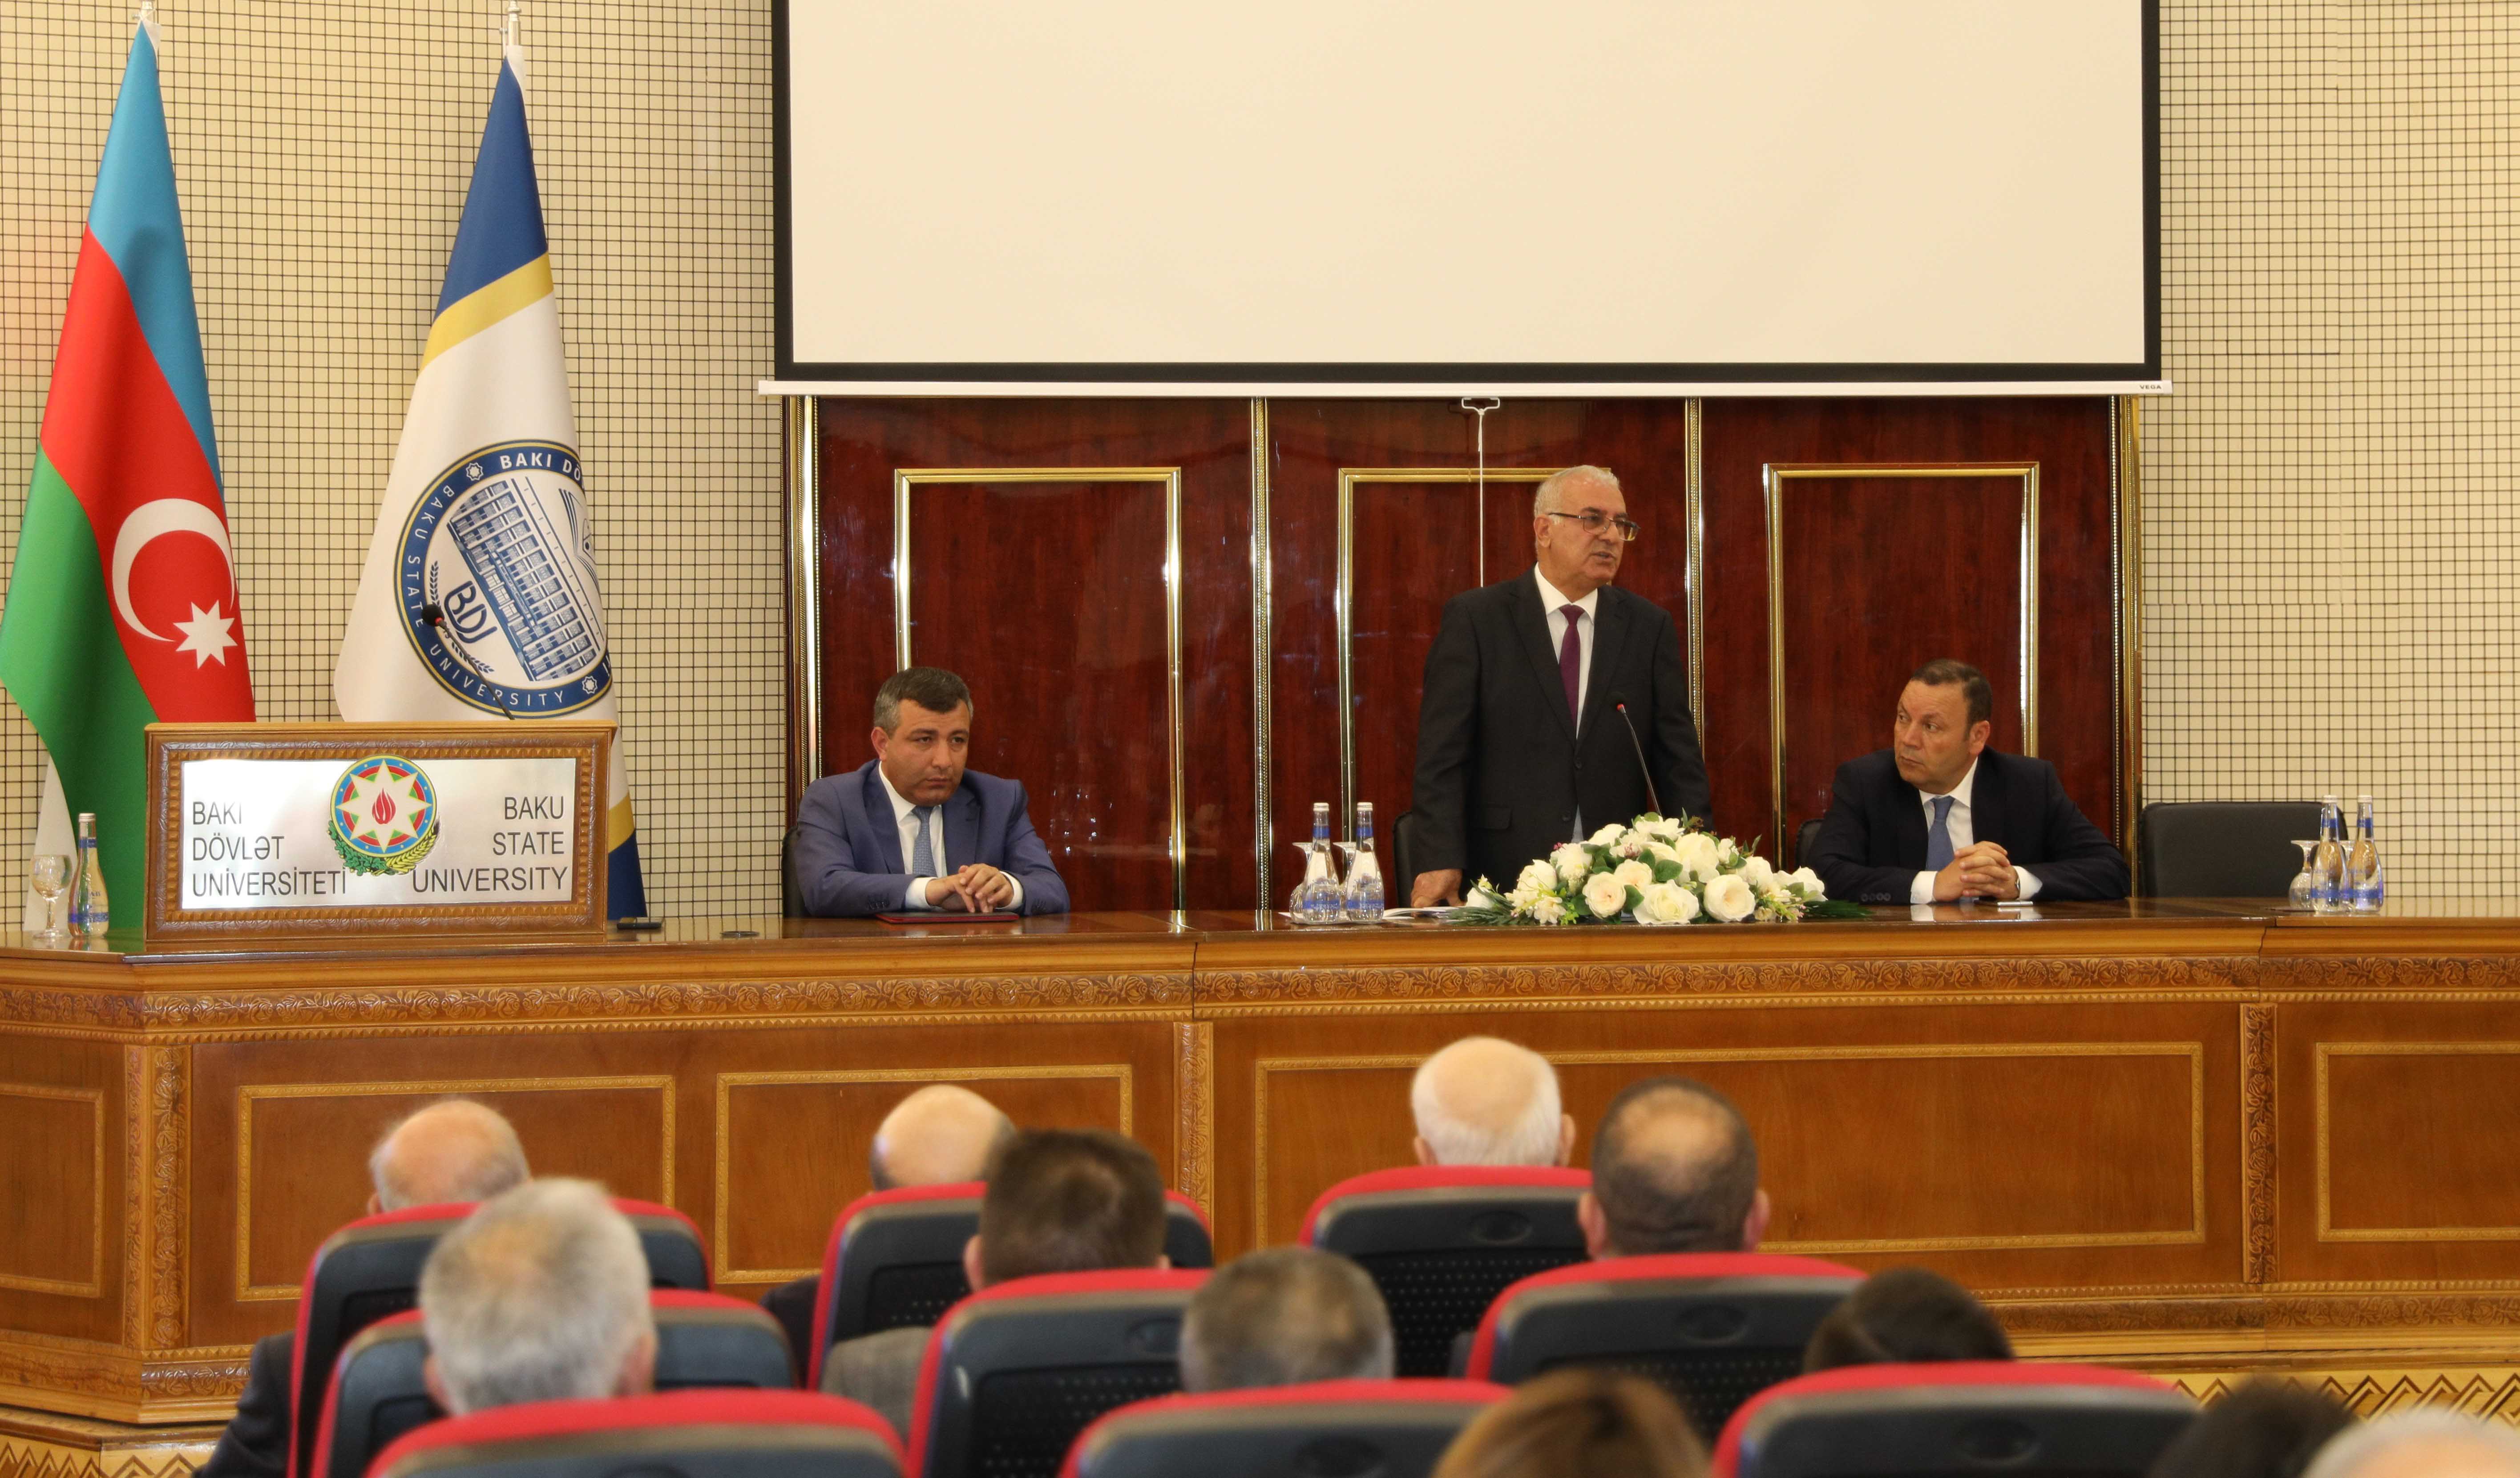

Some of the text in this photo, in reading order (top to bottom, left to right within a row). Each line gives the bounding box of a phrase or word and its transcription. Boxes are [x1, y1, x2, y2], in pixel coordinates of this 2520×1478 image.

[500, 452, 552, 470] BAKI
[407, 485, 563, 706] BAKU STATE UNIVERSITY
[193, 801, 242, 825] BAKI
[504, 796, 564, 820] BAKU
[193, 832, 285, 861] DÖVLƏT
[493, 831, 565, 856] STATE
[193, 866, 346, 897] UNİVERSİTETİ
[412, 866, 568, 893] UNIVERSITY
